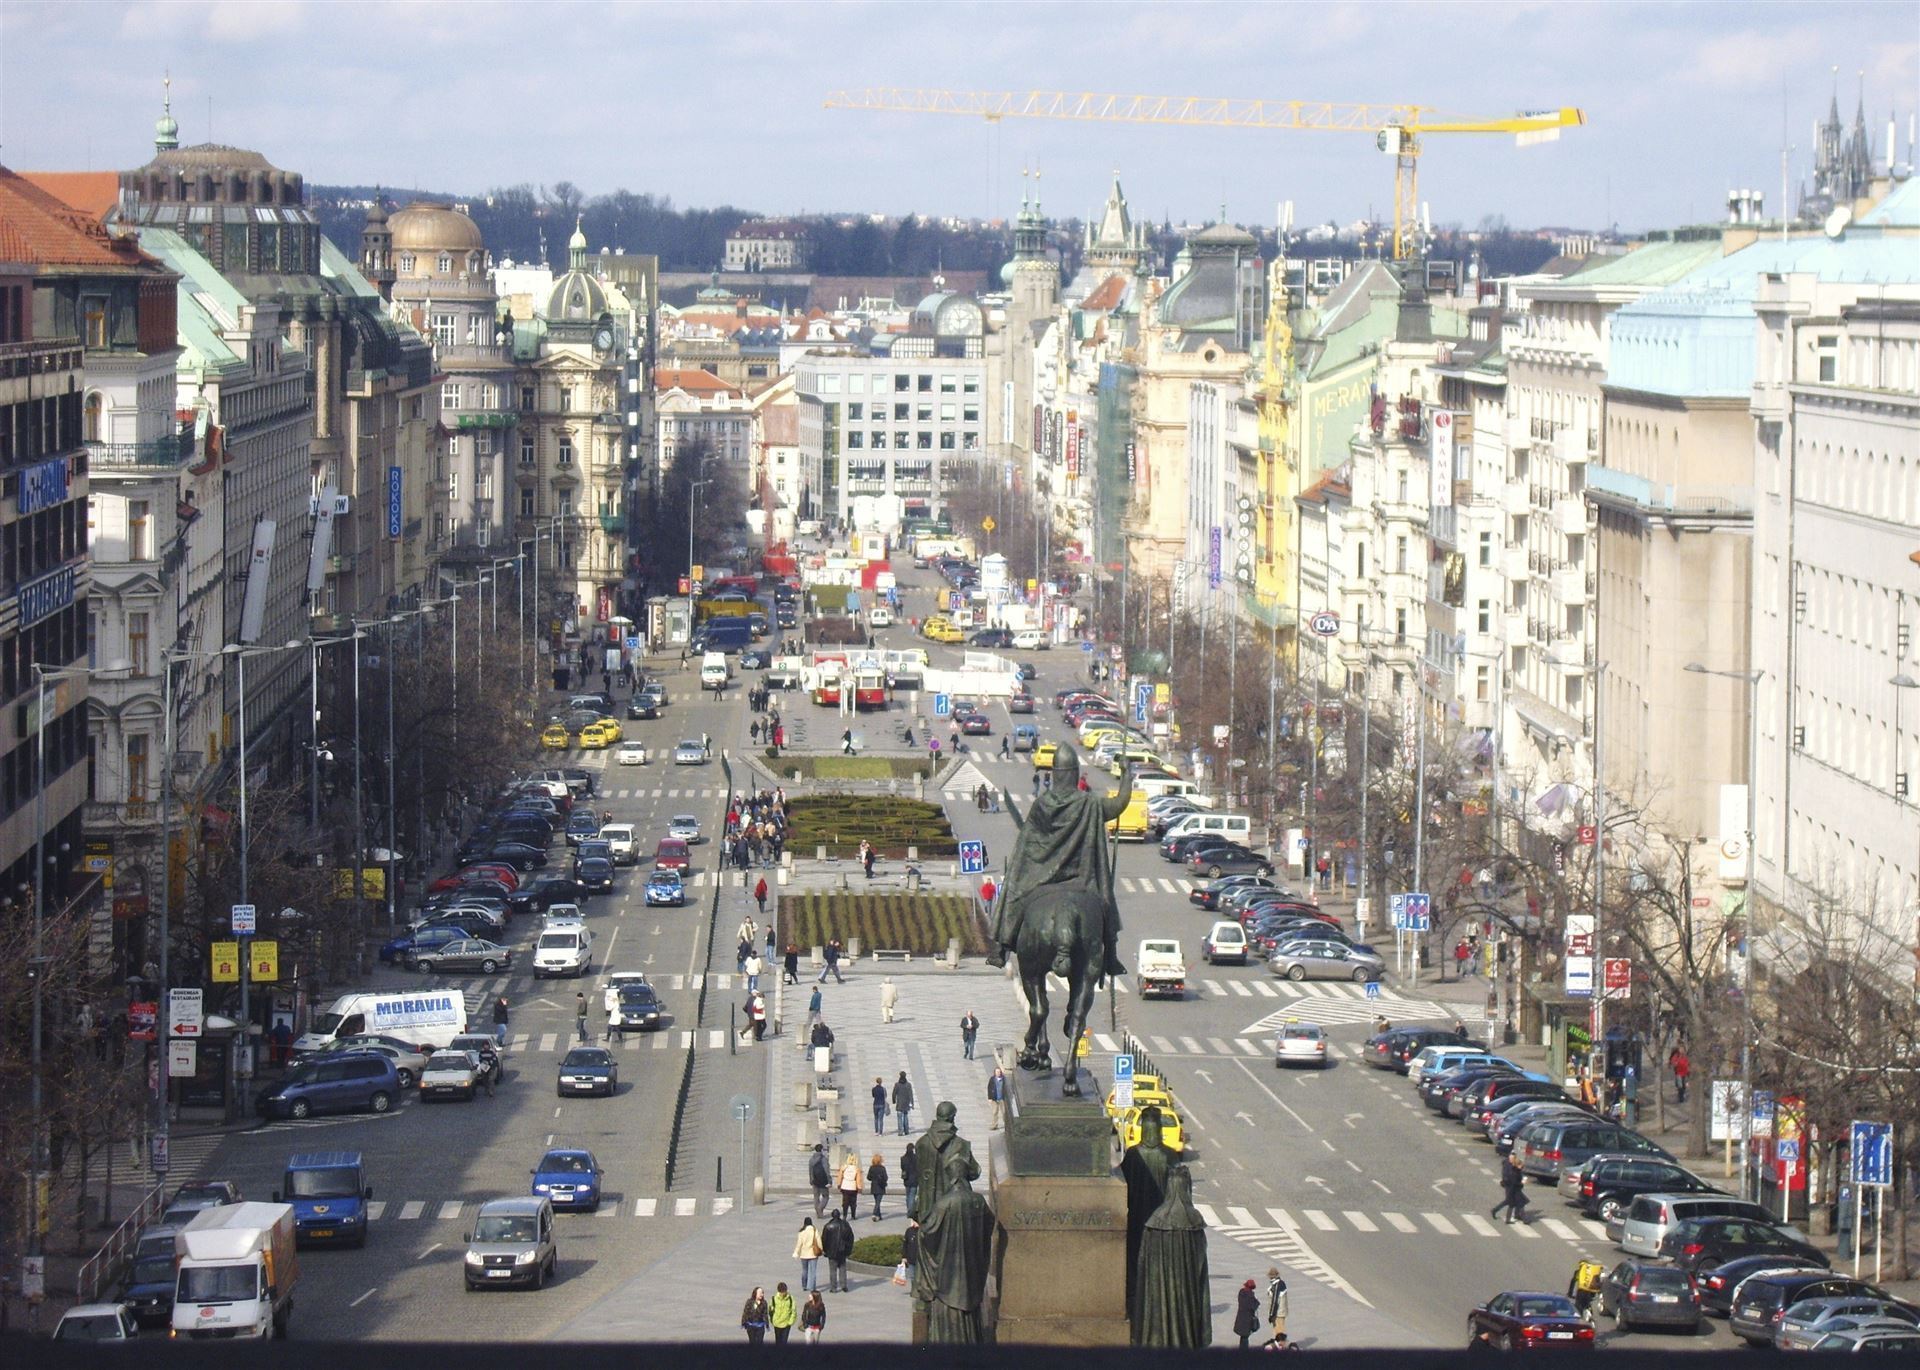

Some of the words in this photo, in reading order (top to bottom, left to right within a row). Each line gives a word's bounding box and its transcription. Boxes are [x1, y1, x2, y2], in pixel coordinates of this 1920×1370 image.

[1127, 444, 1136, 480] SEPHORA
[1437, 435, 1447, 505] RAMADA
[391, 470, 400, 535] ROKOKO
[376, 998, 452, 1015] MORAVIA
[1118, 1058, 1130, 1074] P
